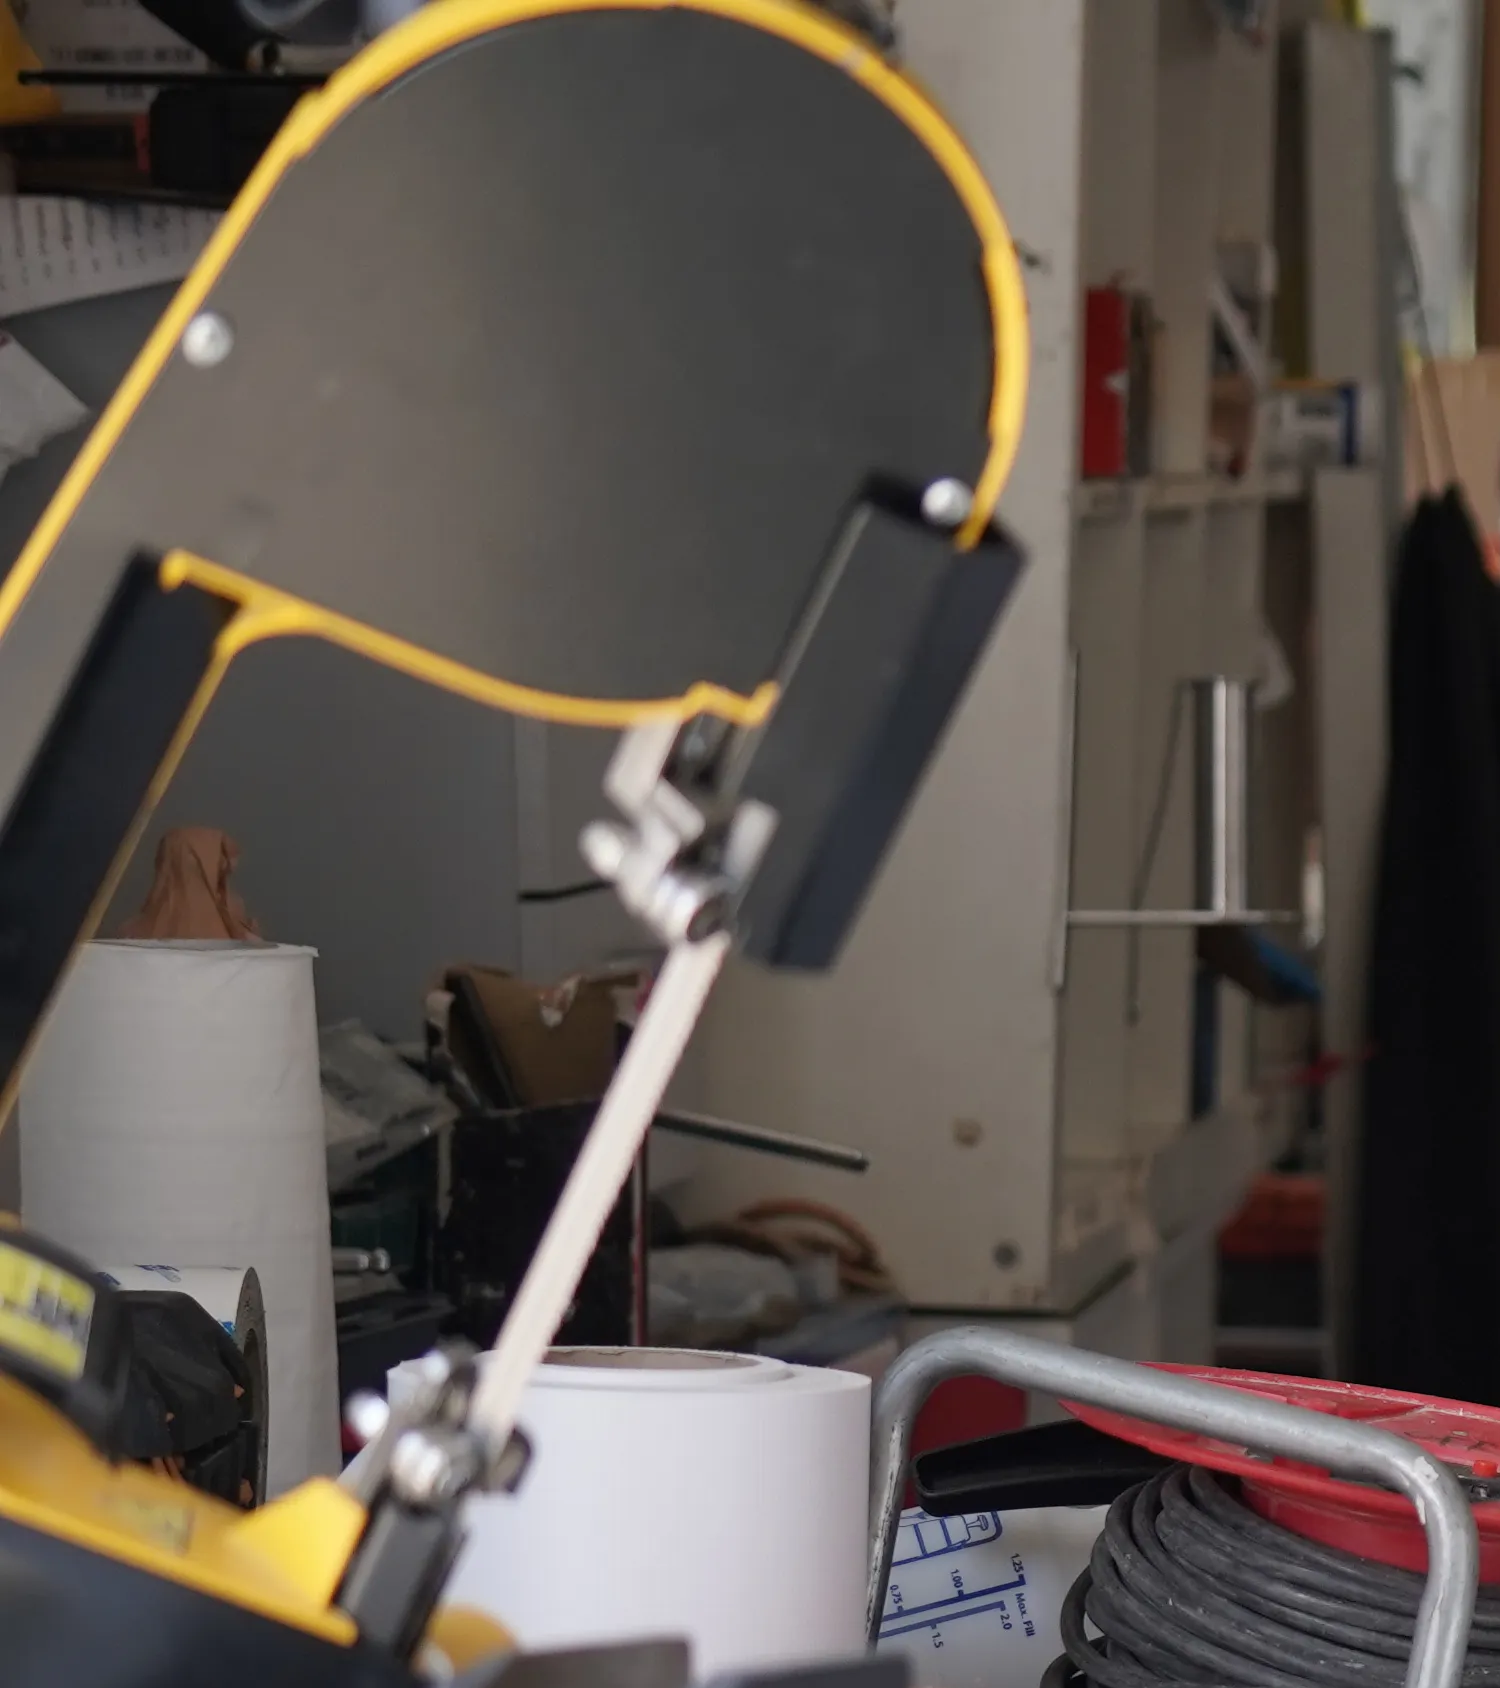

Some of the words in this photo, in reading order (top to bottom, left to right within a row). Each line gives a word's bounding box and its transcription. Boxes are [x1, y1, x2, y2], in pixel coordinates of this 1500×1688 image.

[1009, 1552, 1025, 1574] 1.25
[950, 1568, 964, 1589] 1.00
[889, 1585, 903, 1605] 0.75
[1000, 1613, 1013, 1631] 2.0
[1014, 1592, 1028, 1620] Max.
[1022, 1620, 1036, 1638] Fill
[931, 1631, 945, 1649] 1.5
